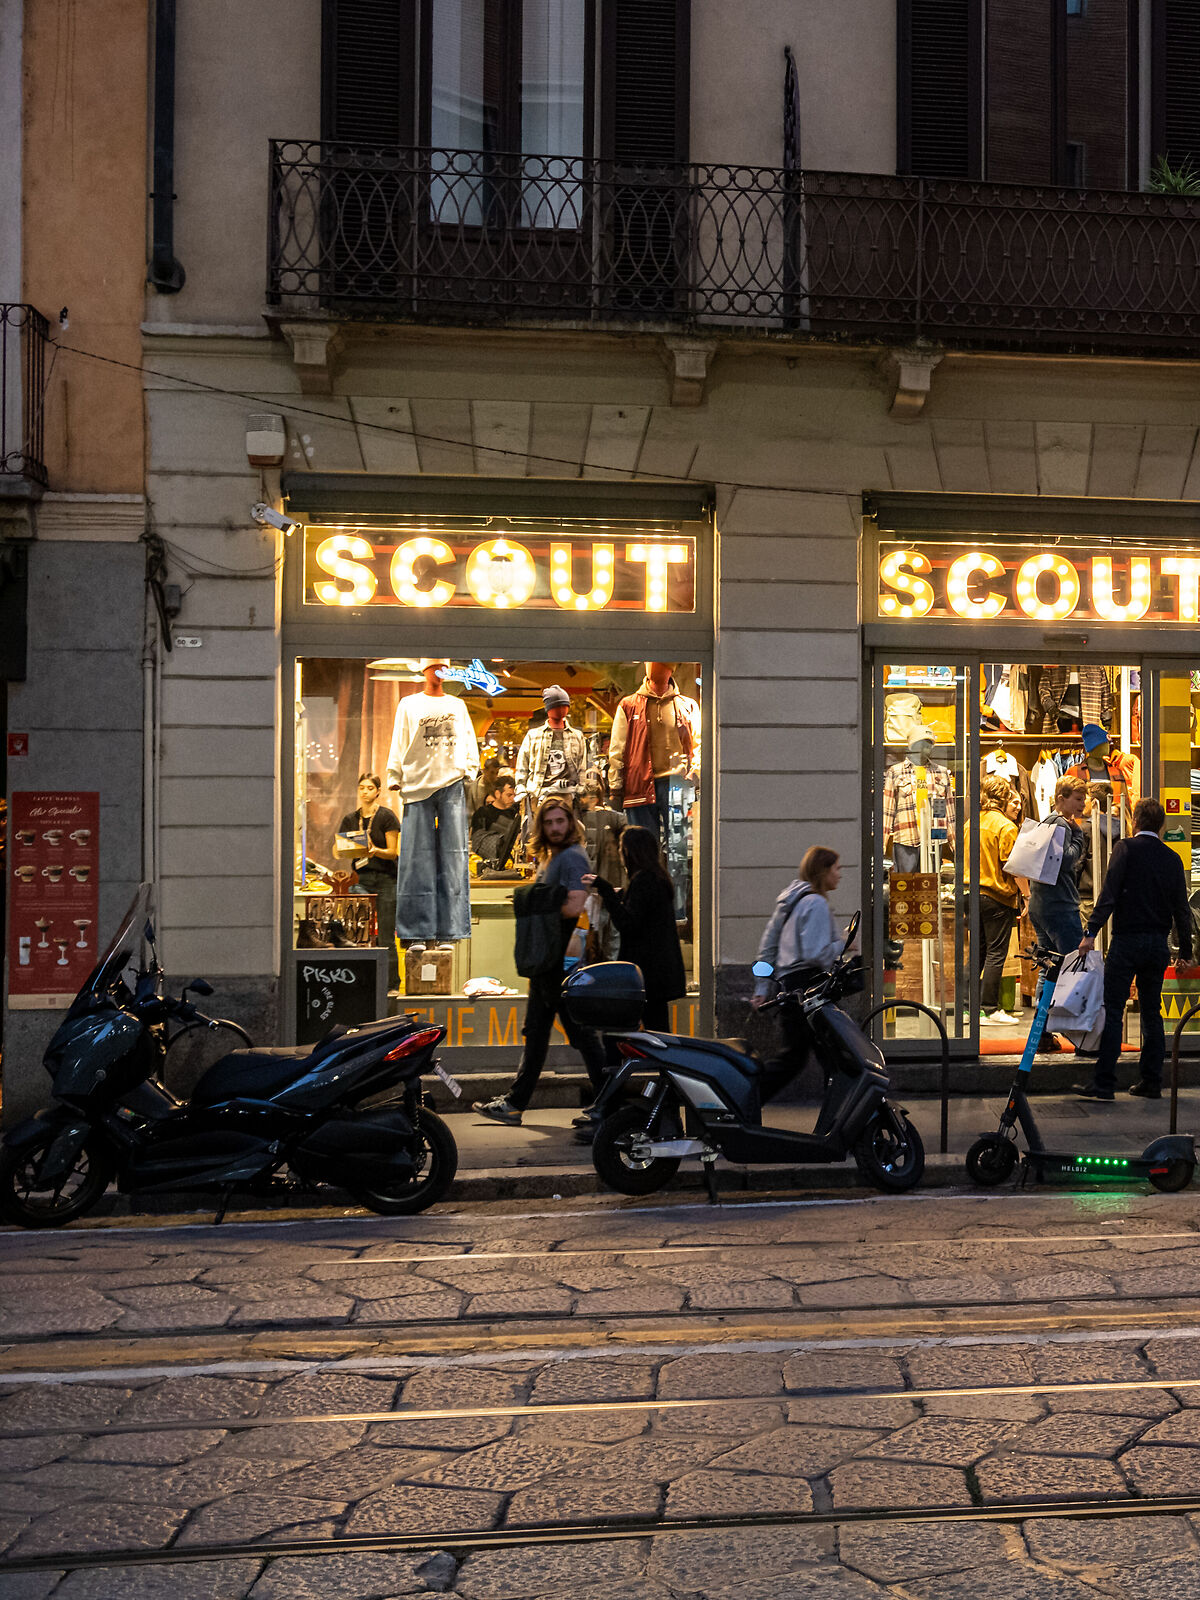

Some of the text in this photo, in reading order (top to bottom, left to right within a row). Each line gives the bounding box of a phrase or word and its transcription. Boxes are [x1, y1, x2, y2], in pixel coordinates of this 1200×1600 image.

[313, 534, 688, 612] SCOUT
[1028, 1004, 1049, 1055] HELBIZ
[1061, 1164, 1088, 1174] HELBIZ
